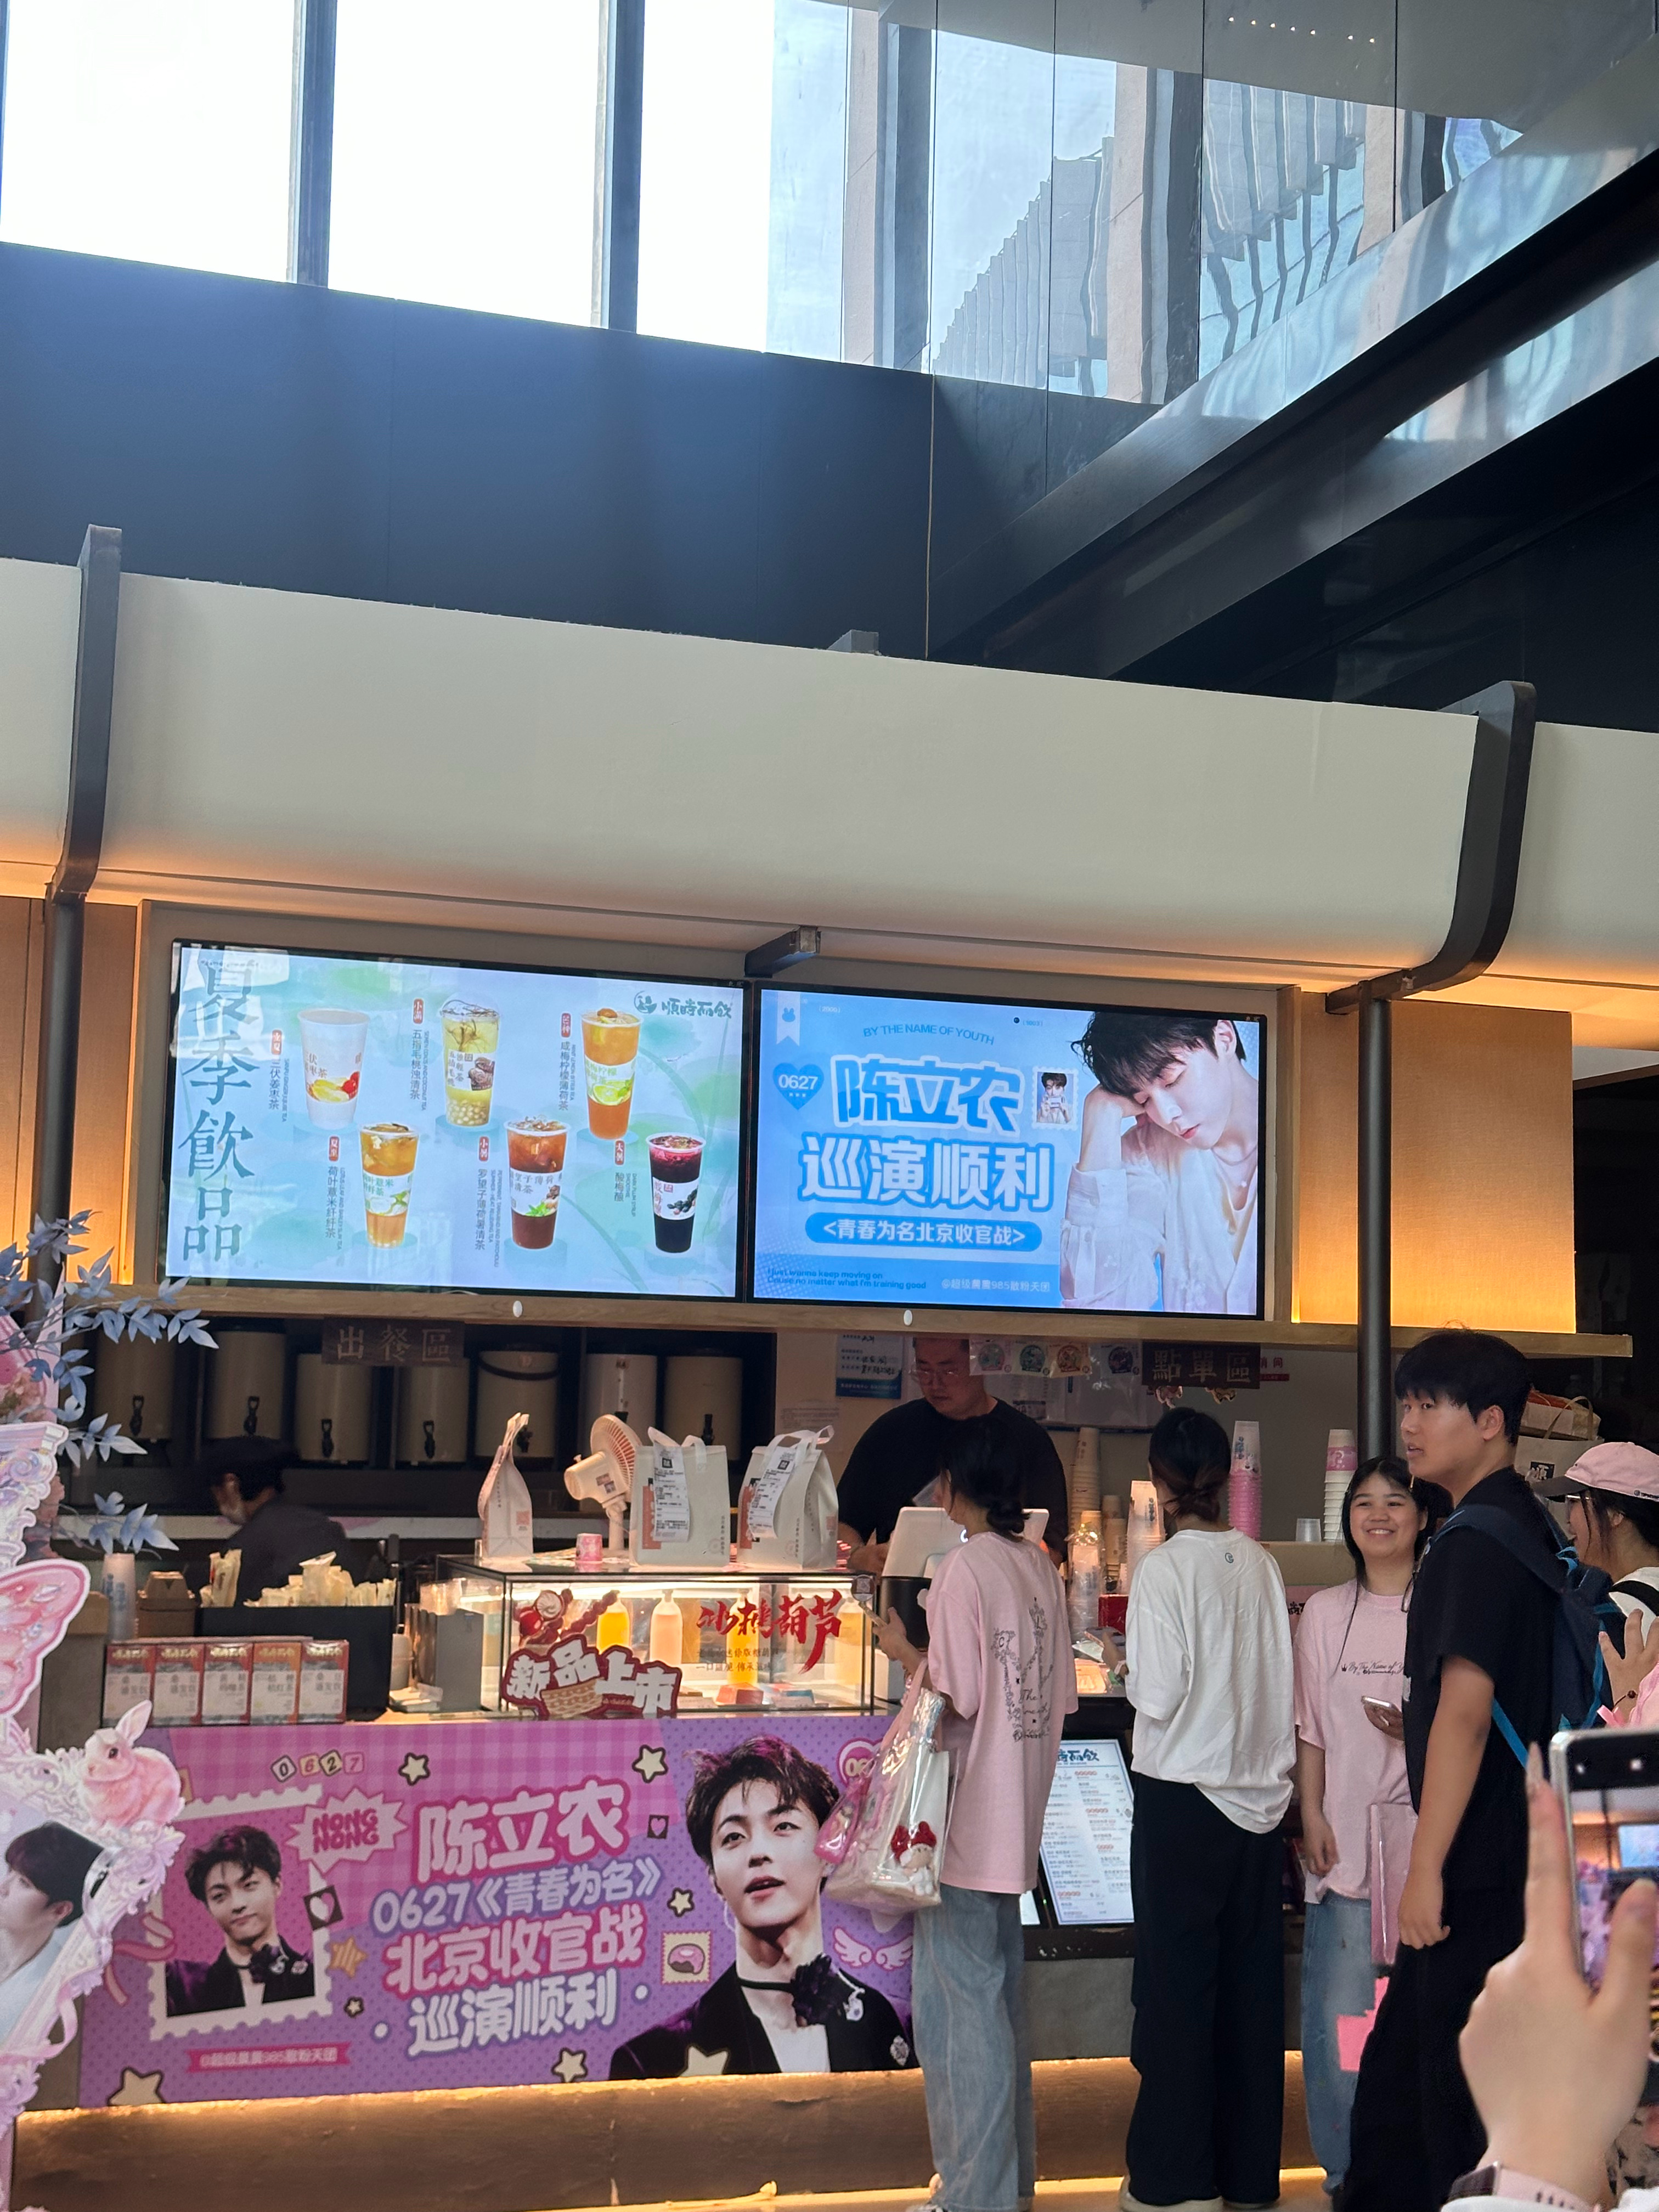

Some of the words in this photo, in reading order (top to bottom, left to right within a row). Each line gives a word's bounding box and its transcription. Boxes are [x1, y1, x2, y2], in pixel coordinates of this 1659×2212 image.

[864, 1026, 878, 1038] BY
[881, 1024, 904, 1035] THE
[905, 1024, 936, 1034] NAME
[939, 1026, 953, 1036] OF
[955, 1028, 995, 1046] YOUTH
[778, 1074, 819, 1090] 0627
[831, 1054, 1024, 1135] 陈立农
[800, 1135, 1052, 1210] 巡演顺利
[823, 1218, 1025, 1245] <青春为名北京收官战>
[819, 1270, 838, 1278] keep
[841, 1271, 871, 1280] moving
[873, 1281, 905, 1290] training
[1153, 1348, 1251, 1383] 點單區
[506, 1639, 678, 1714] 新品上市
[1348, 1661, 1358, 1674] By
[278, 1752, 360, 1777] 0627
[313, 1809, 378, 1839] NONG
[417, 1779, 625, 1884] 陈立农
[314, 1828, 379, 1853] NONG
[385, 1903, 644, 1994] 北京收官战
[407, 1968, 618, 2057] 巡演顺利
